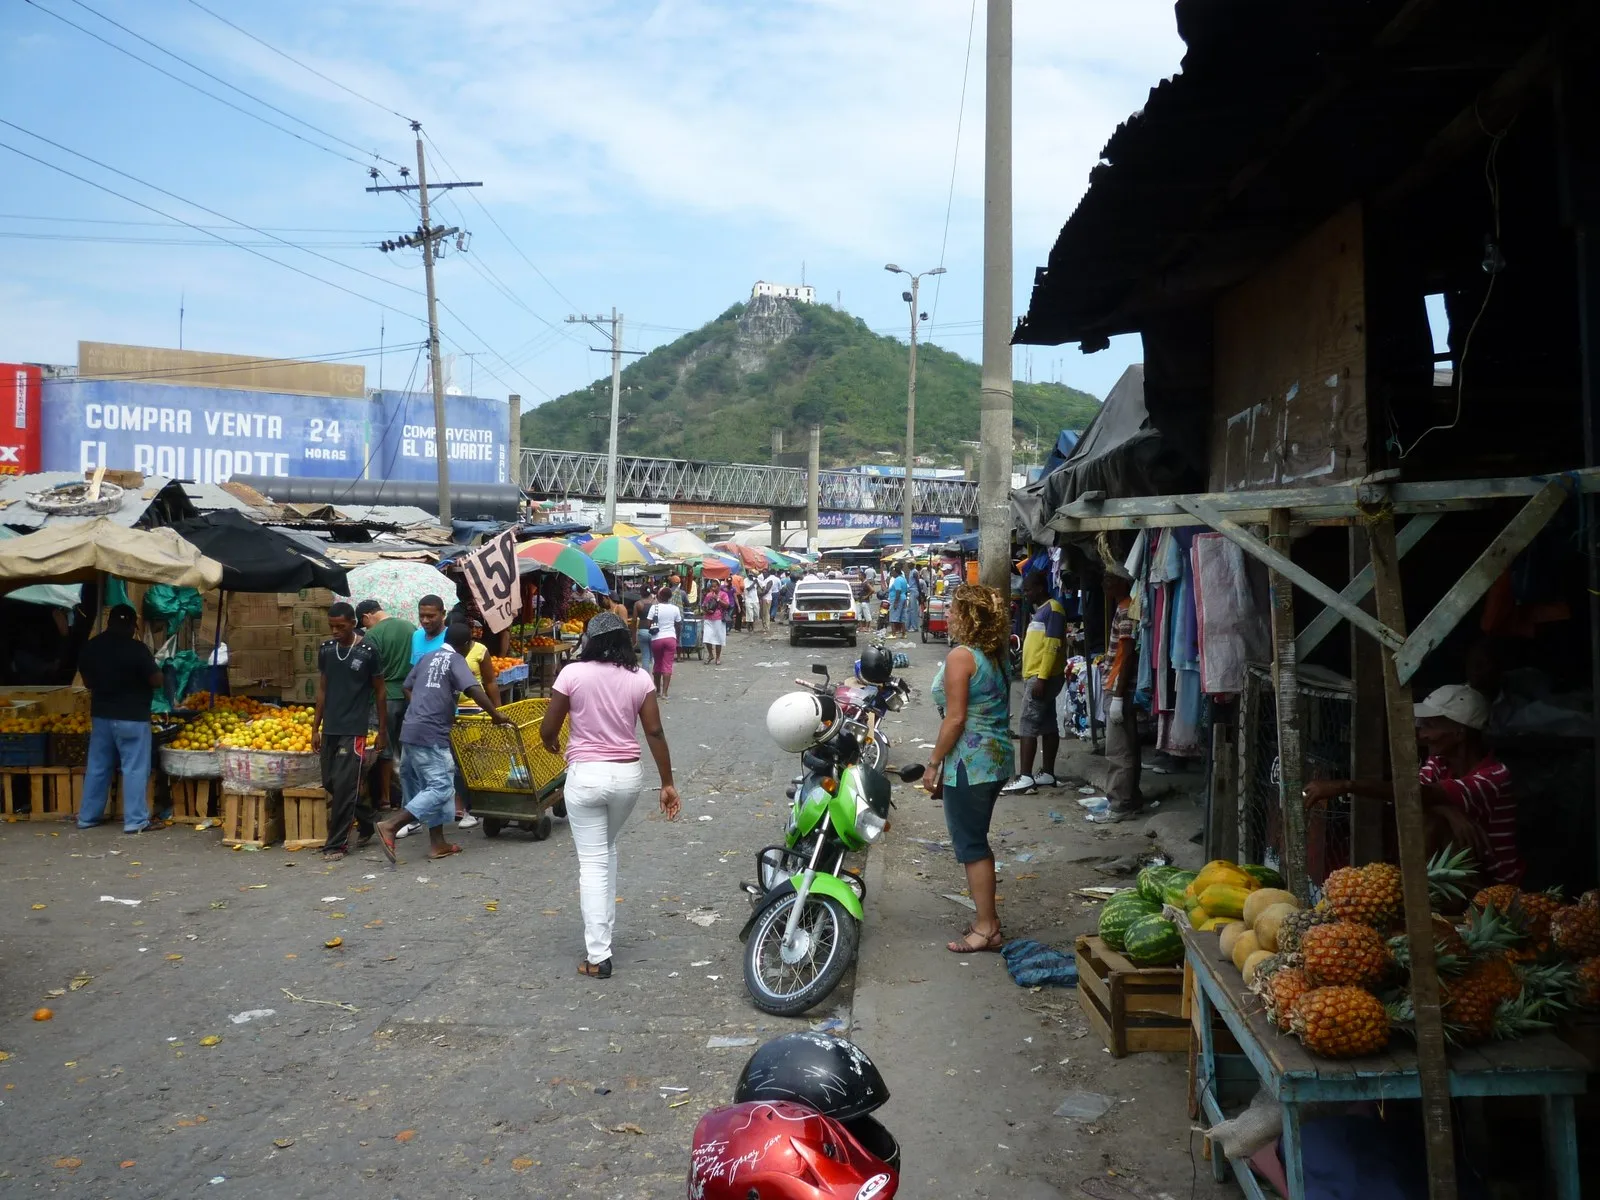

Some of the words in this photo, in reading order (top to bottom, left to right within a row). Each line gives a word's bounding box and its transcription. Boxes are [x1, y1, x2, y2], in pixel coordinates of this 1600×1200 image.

[86, 404, 192, 434] COMPRA
[204, 411, 282, 439] VENTA
[310, 418, 341, 444] 24
[305, 447, 346, 461] HORAS
[402, 439, 419, 457] EL
[760, 907, 774, 926] CITY
